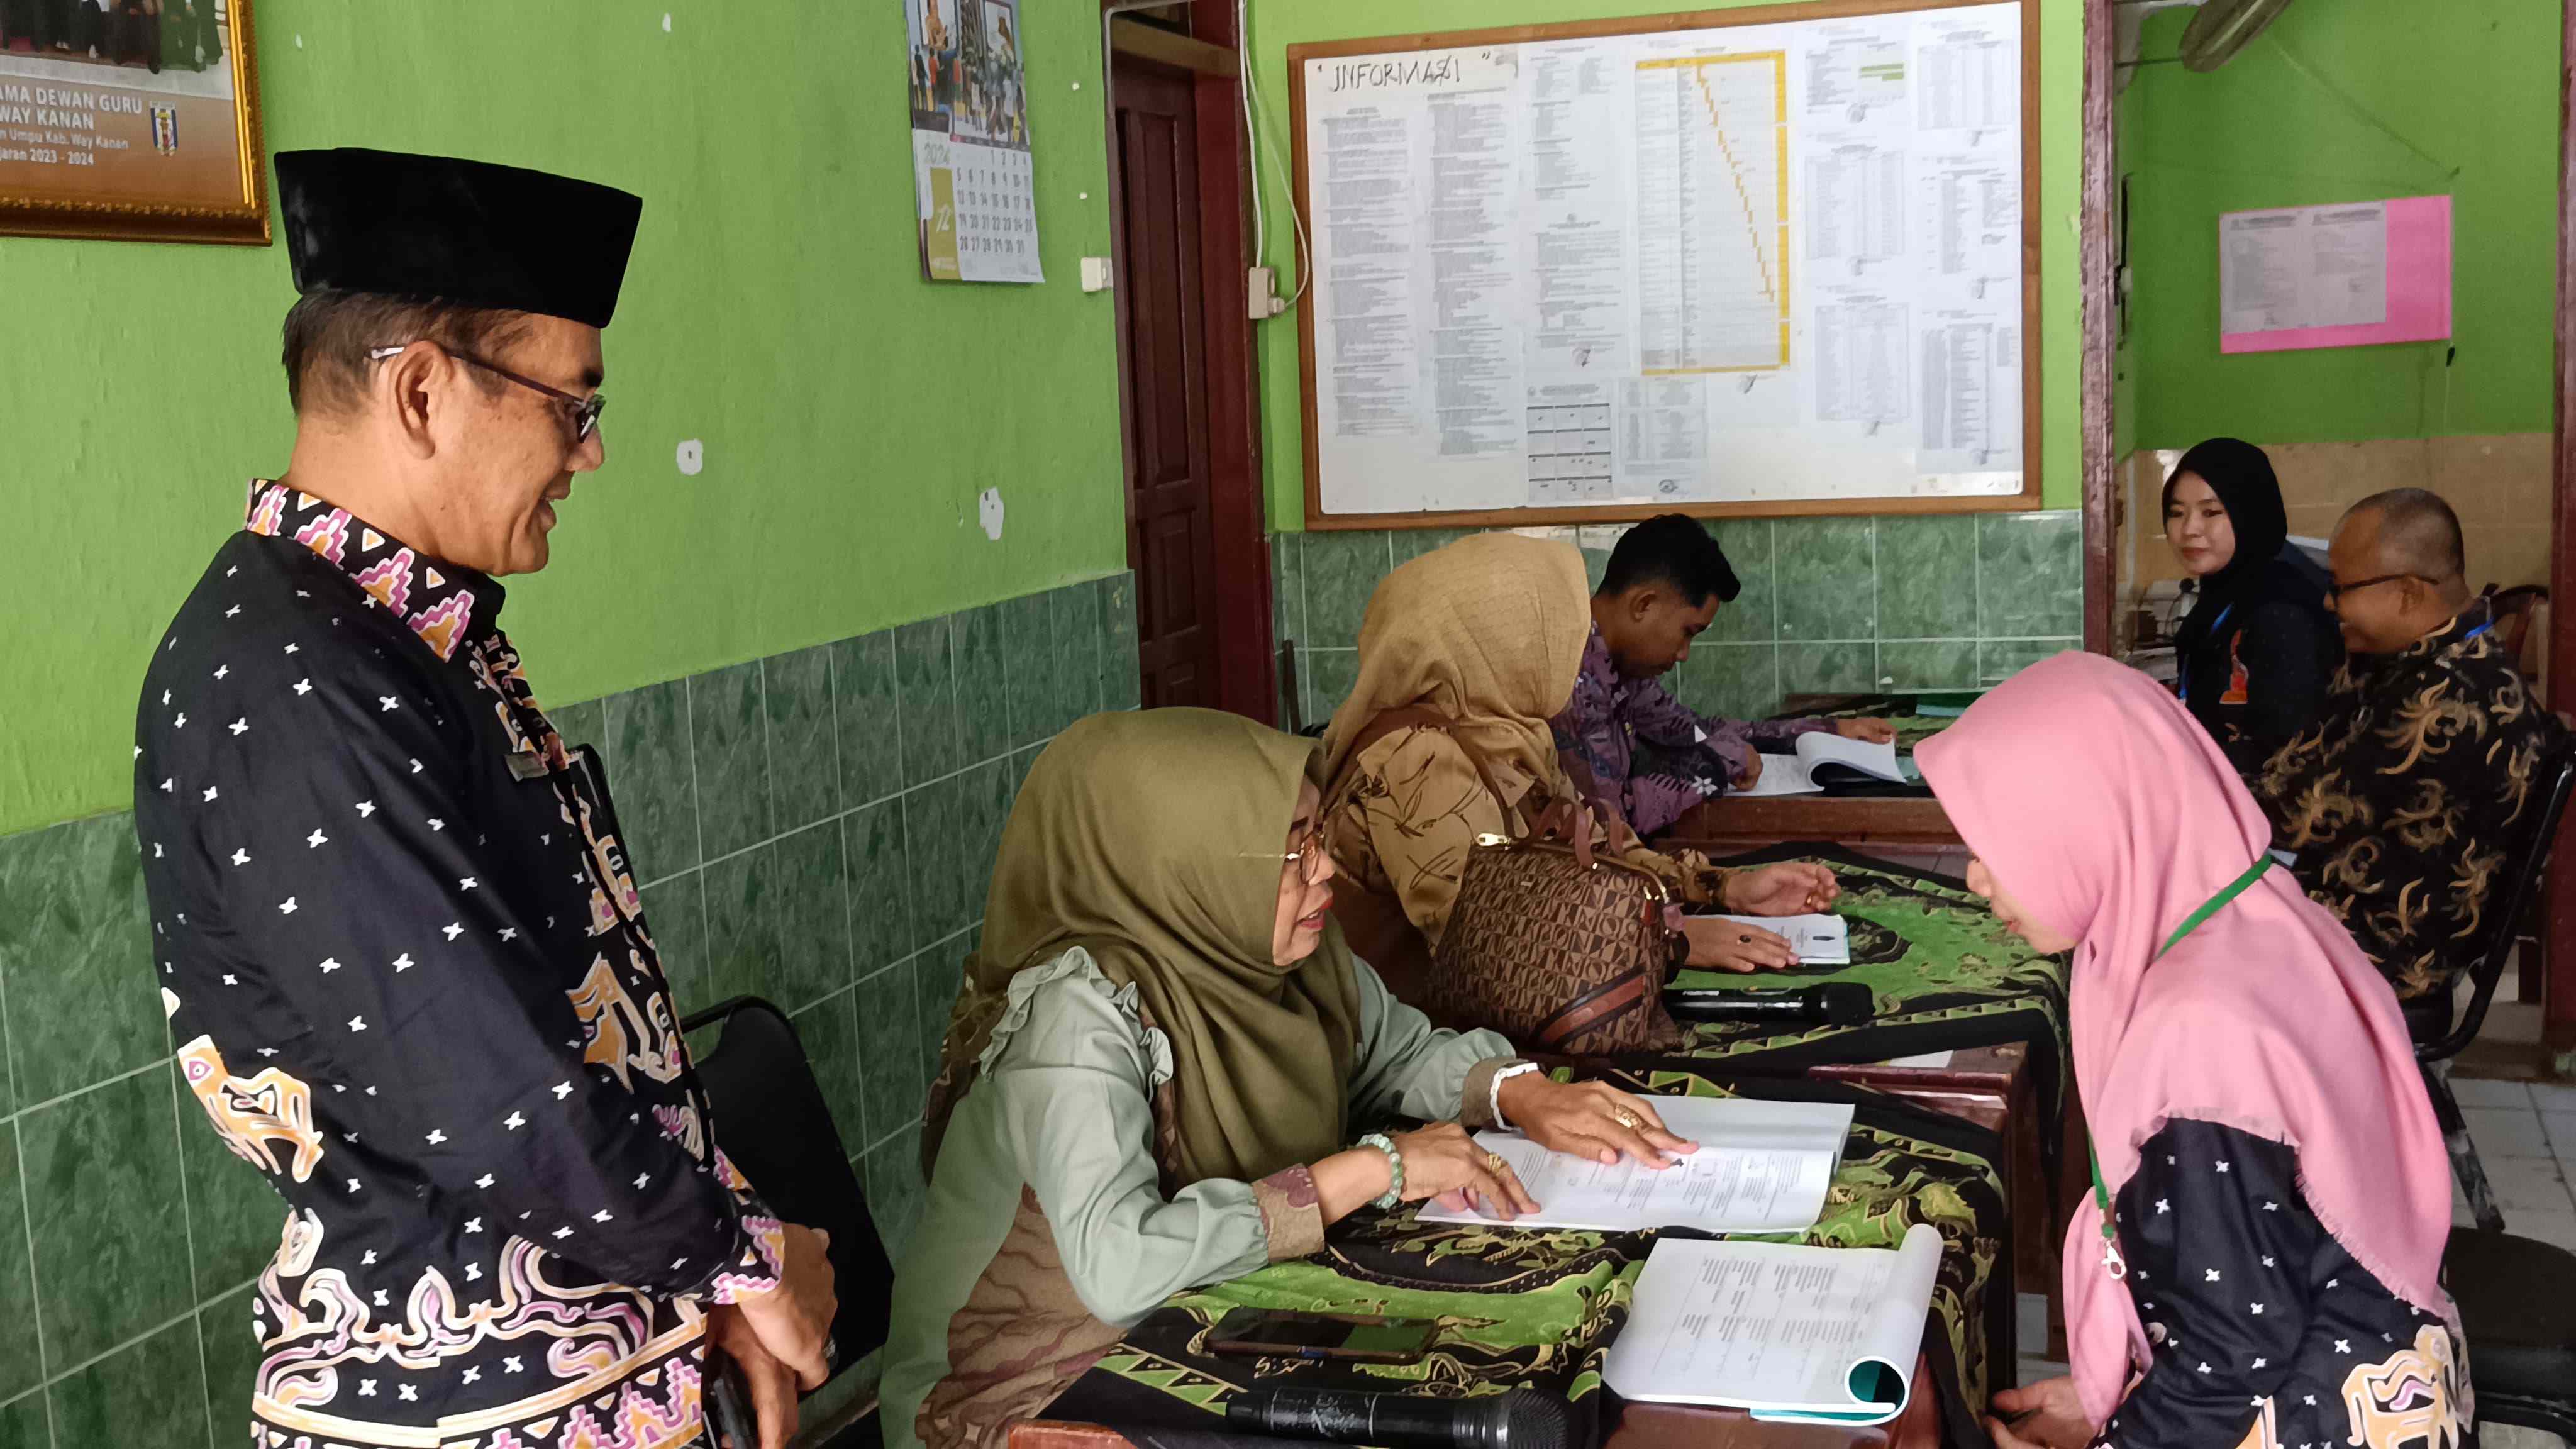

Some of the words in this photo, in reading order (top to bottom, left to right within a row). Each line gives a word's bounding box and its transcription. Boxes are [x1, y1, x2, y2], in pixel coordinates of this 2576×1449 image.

[36, 87, 94, 110] DEWAN
[99, 95, 142, 114] GURU
[37, 109, 93, 129] KANAN
[70, 133, 93, 150] Way
[96, 135, 130, 150] Kanan
[30, 148, 57, 163] 2023
[66, 151, 94, 165] 2024
[924, 142, 950, 165] 2024
